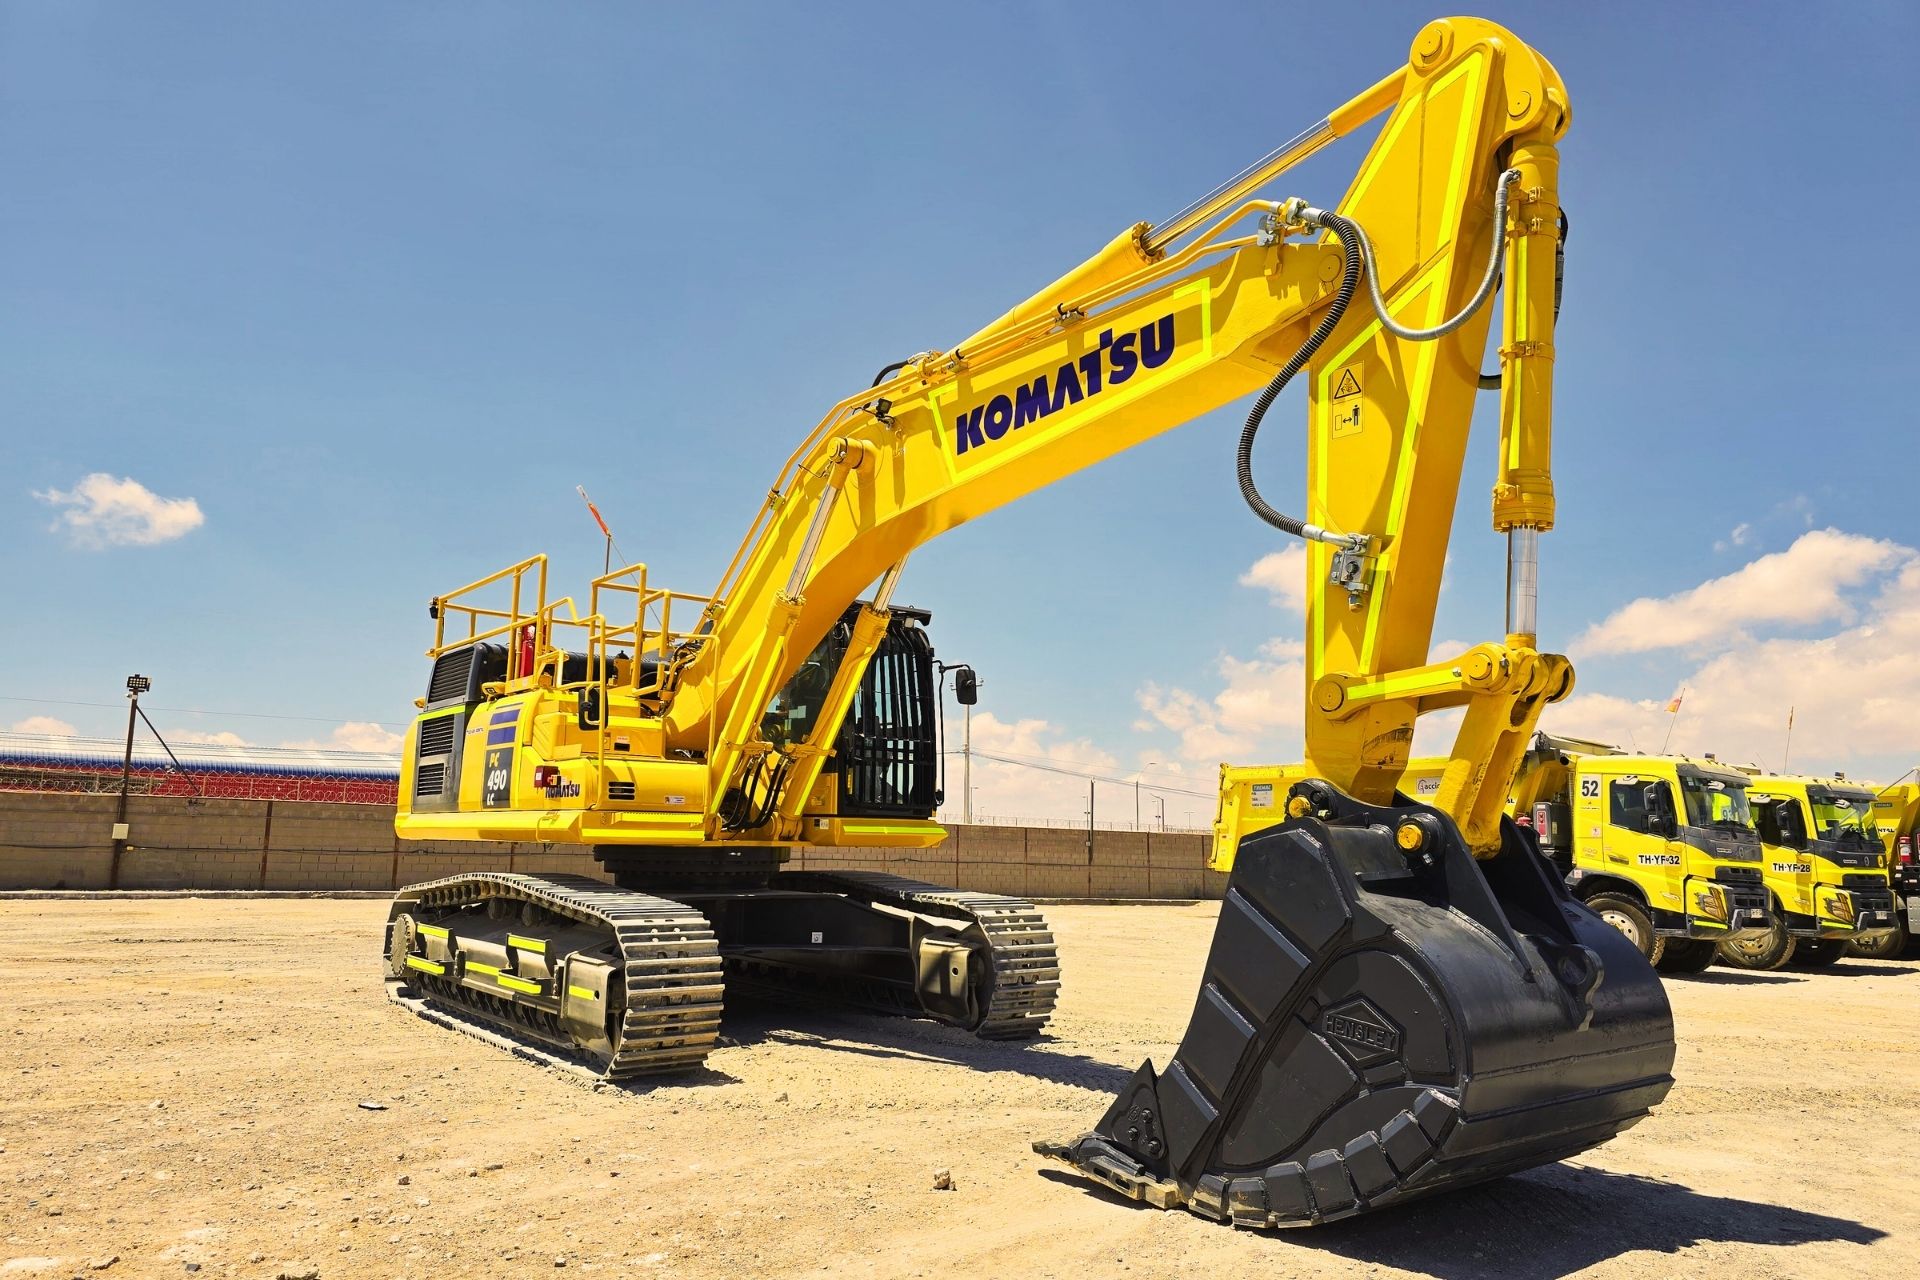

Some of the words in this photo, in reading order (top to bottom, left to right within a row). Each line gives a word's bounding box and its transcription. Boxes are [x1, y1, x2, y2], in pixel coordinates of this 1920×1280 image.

[957, 313, 1175, 455] KOMATSU
[489, 751, 500, 768] PC
[487, 769, 507, 791] 490
[545, 780, 581, 798] KOMATSU
[1581, 780, 1599, 797] 52
[486, 792, 495, 806] LC
[1326, 1015, 1396, 1049] HENSLEY
